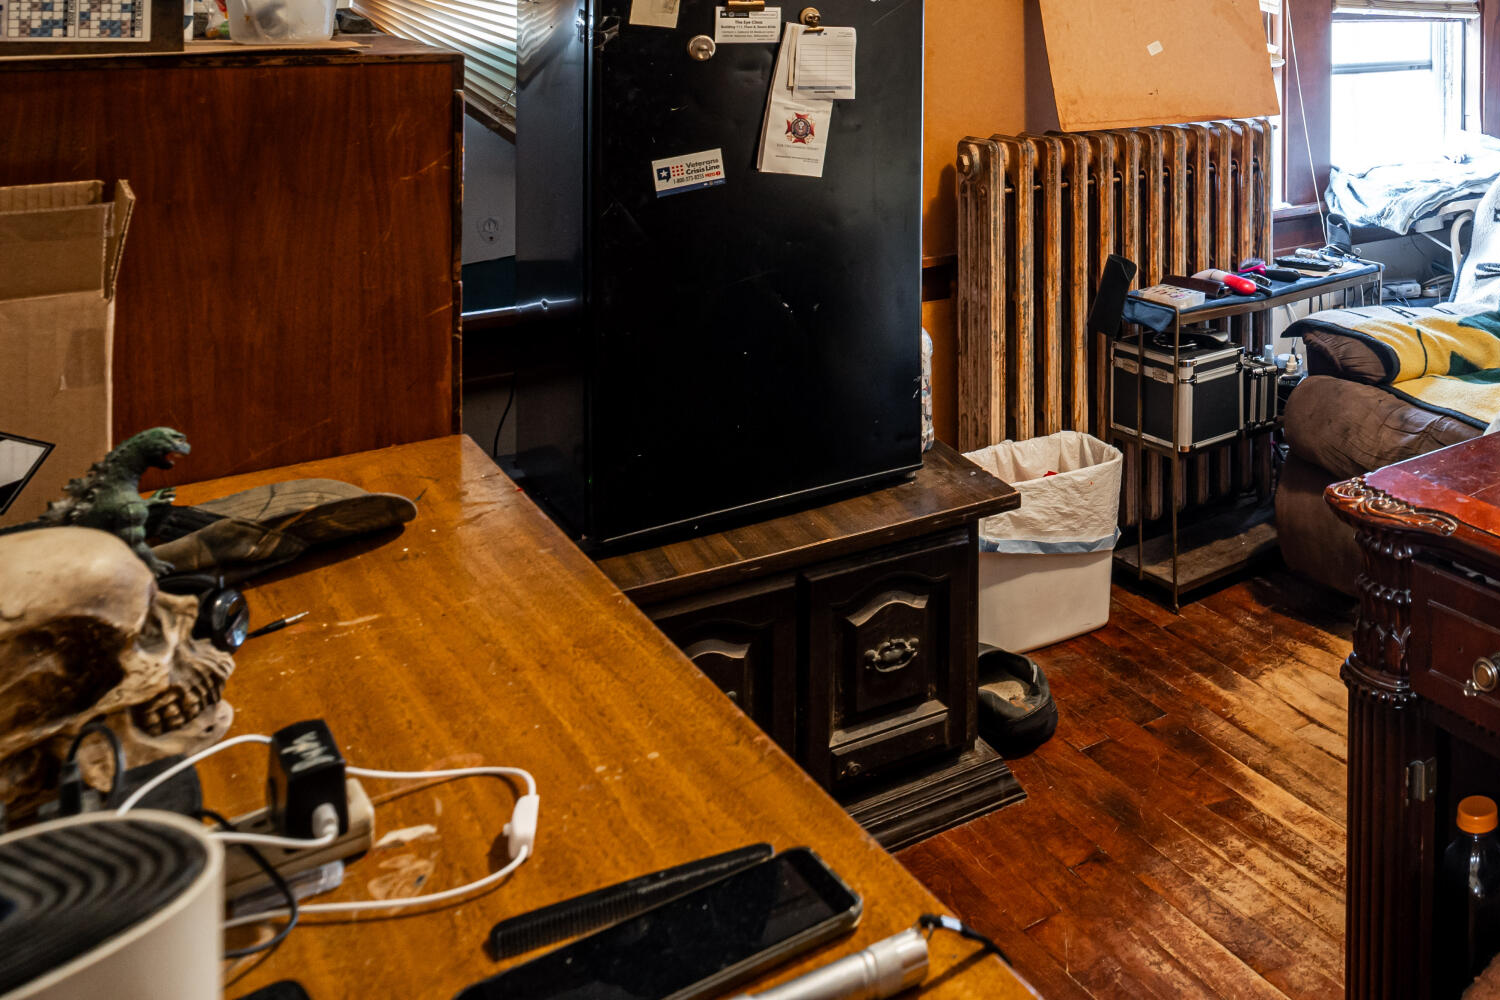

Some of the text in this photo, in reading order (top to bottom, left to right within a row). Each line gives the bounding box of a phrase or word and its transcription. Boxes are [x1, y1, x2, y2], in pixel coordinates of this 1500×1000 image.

[686, 158, 719, 168] Veterans
[686, 164, 720, 175] Crisis Line
